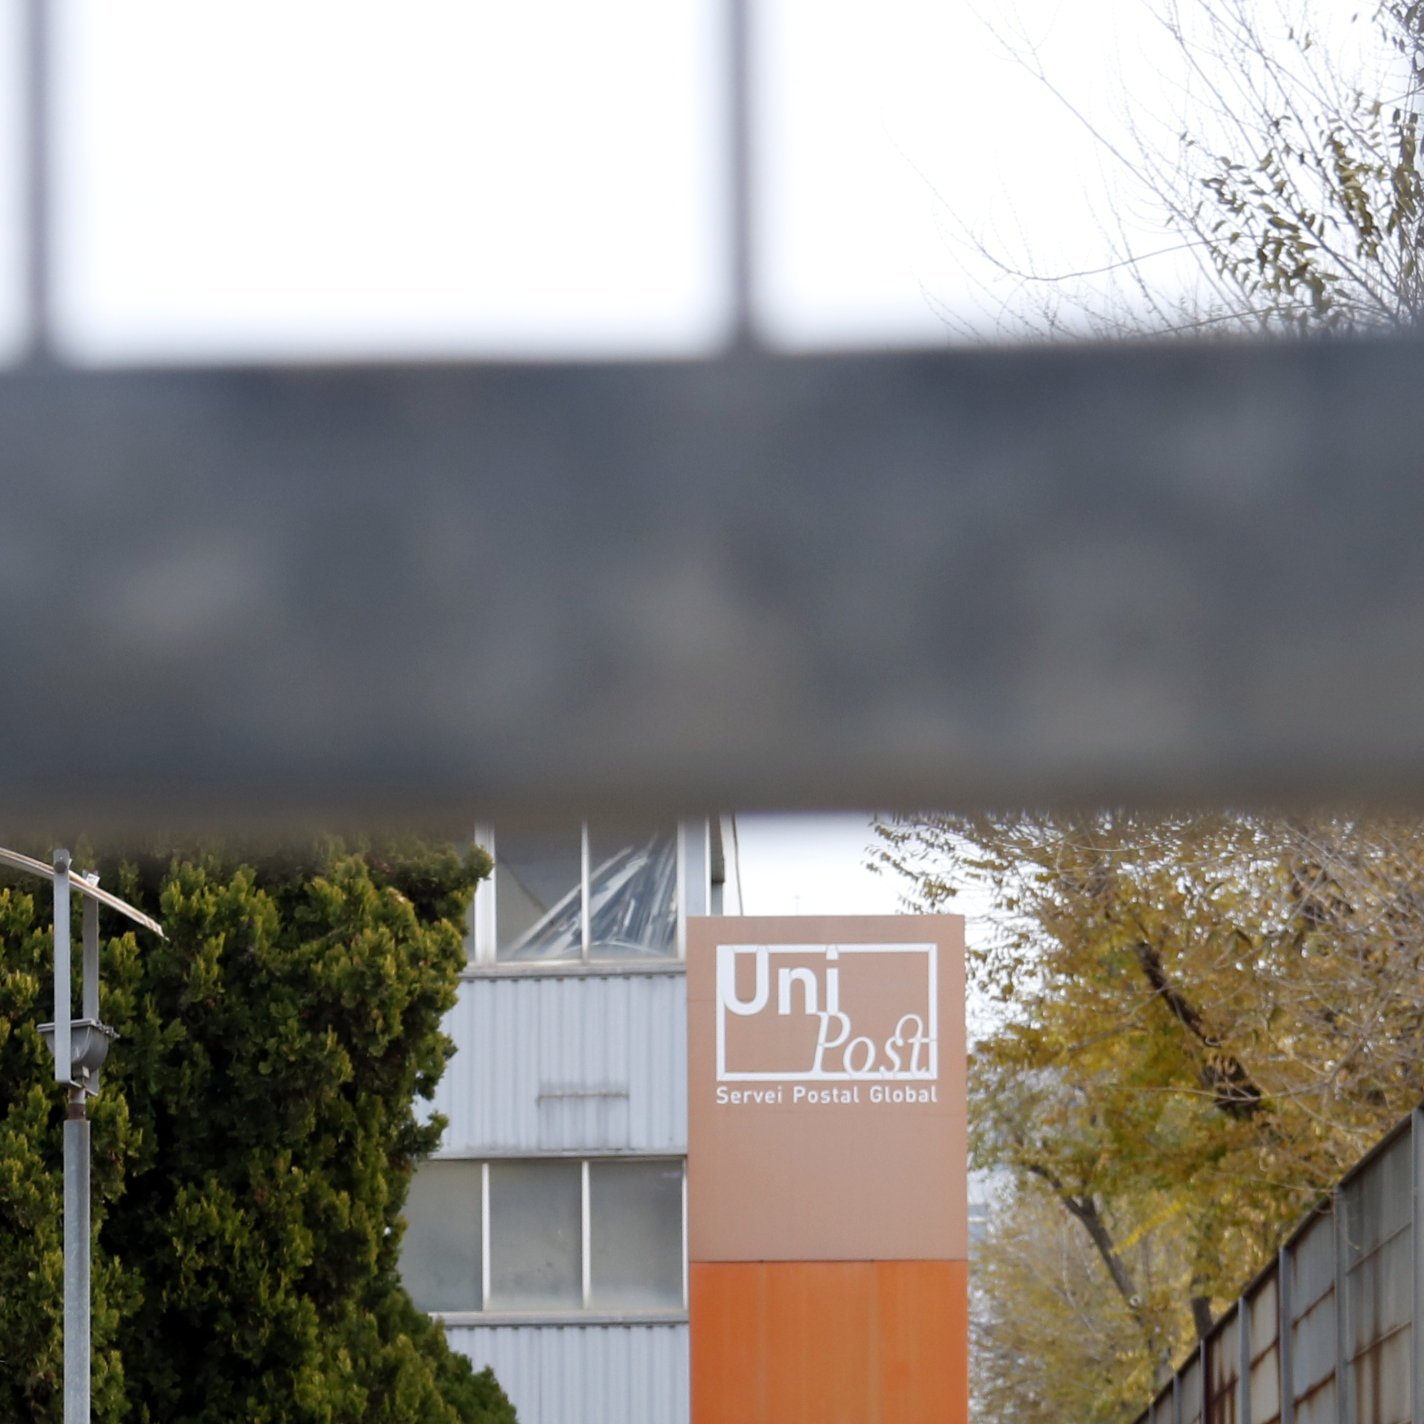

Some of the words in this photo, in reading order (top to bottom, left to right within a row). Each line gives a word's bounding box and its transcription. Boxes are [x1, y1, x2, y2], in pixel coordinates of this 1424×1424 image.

[716, 945, 840, 1016] Uni
[808, 1010, 931, 1077] Post
[715, 1085, 783, 1105] Servei
[792, 1085, 860, 1104] Postal
[869, 1085, 938, 1104] Global
